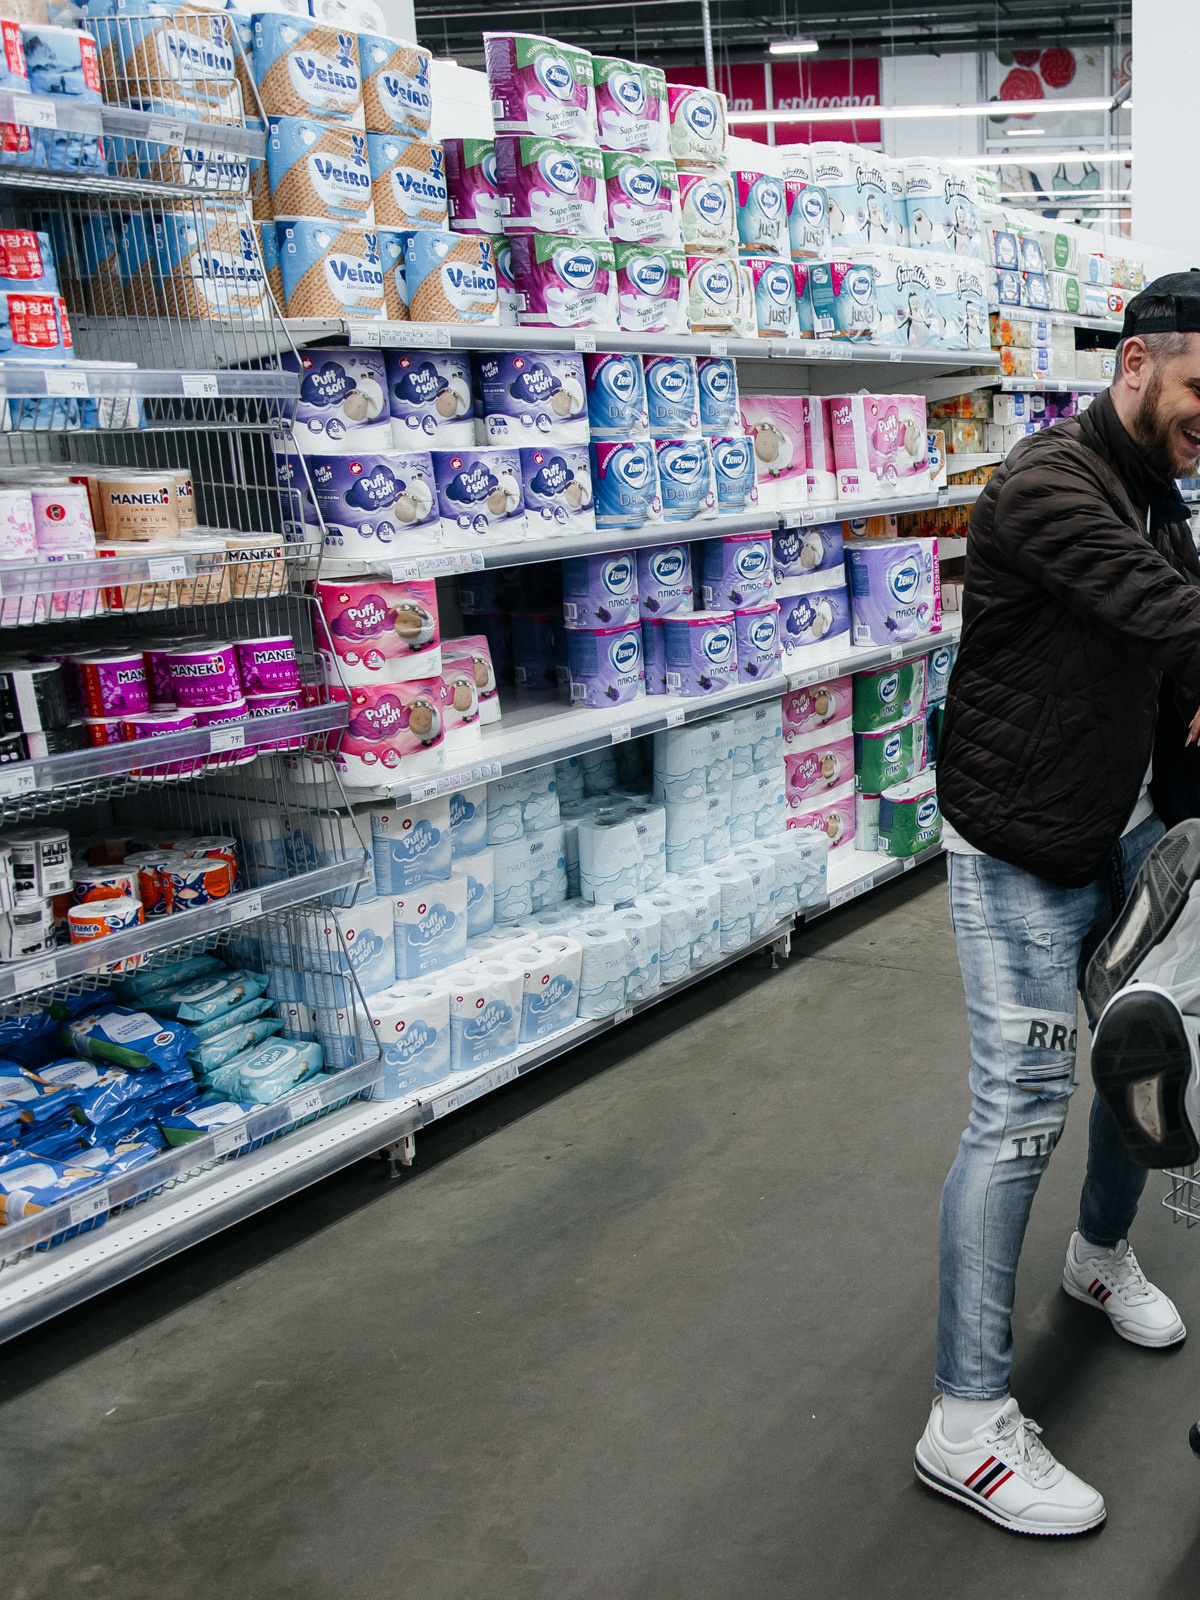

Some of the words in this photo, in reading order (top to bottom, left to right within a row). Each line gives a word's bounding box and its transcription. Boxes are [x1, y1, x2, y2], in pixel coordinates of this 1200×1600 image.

[295, 54, 358, 90] Veiro
[384, 75, 430, 108] Veiro
[314, 157, 369, 188] Veiro
[397, 171, 446, 199] Veiro
[330, 259, 383, 284] Veiro
[568, 260, 592, 275] Zewa
[641, 269, 662, 280] Zewa
[446, 267, 496, 291] Veiro
[897, 266, 930, 291] familia
[311, 367, 336, 386] Puff
[325, 377, 346, 393] soft
[408, 367, 432, 386] Puff
[422, 375, 439, 392] soft
[522, 370, 544, 386] Puff
[535, 377, 553, 392] soft
[674, 458, 698, 470] Zewa
[725, 452, 743, 465] Zewa
[460, 470, 482, 486] Puff
[542, 464, 559, 479] Puff
[361, 473, 385, 491] Puff
[376, 482, 395, 498] soft
[473, 476, 489, 492] soft
[111, 488, 169, 505] MANEKI
[778, 535, 796, 551] Puff
[659, 558, 680, 572] Zewa
[742, 554, 763, 568] Zewa
[610, 568, 628, 582] Zewa
[897, 573, 916, 588] Zewa
[347, 603, 375, 620] Puff
[363, 609, 386, 628] soft
[615, 643, 634, 660] Zewa
[709, 636, 728, 650] Zewa
[254, 649, 296, 664] MANEK
[170, 656, 225, 677] MANEKI
[365, 703, 392, 720] Puff
[380, 710, 401, 727] soft
[403, 831, 424, 848] Puff
[419, 912, 439, 932] Puff
[540, 983, 557, 1002] Puff
[474, 1007, 493, 1027] Puff
[396, 1031, 416, 1051] Puff
